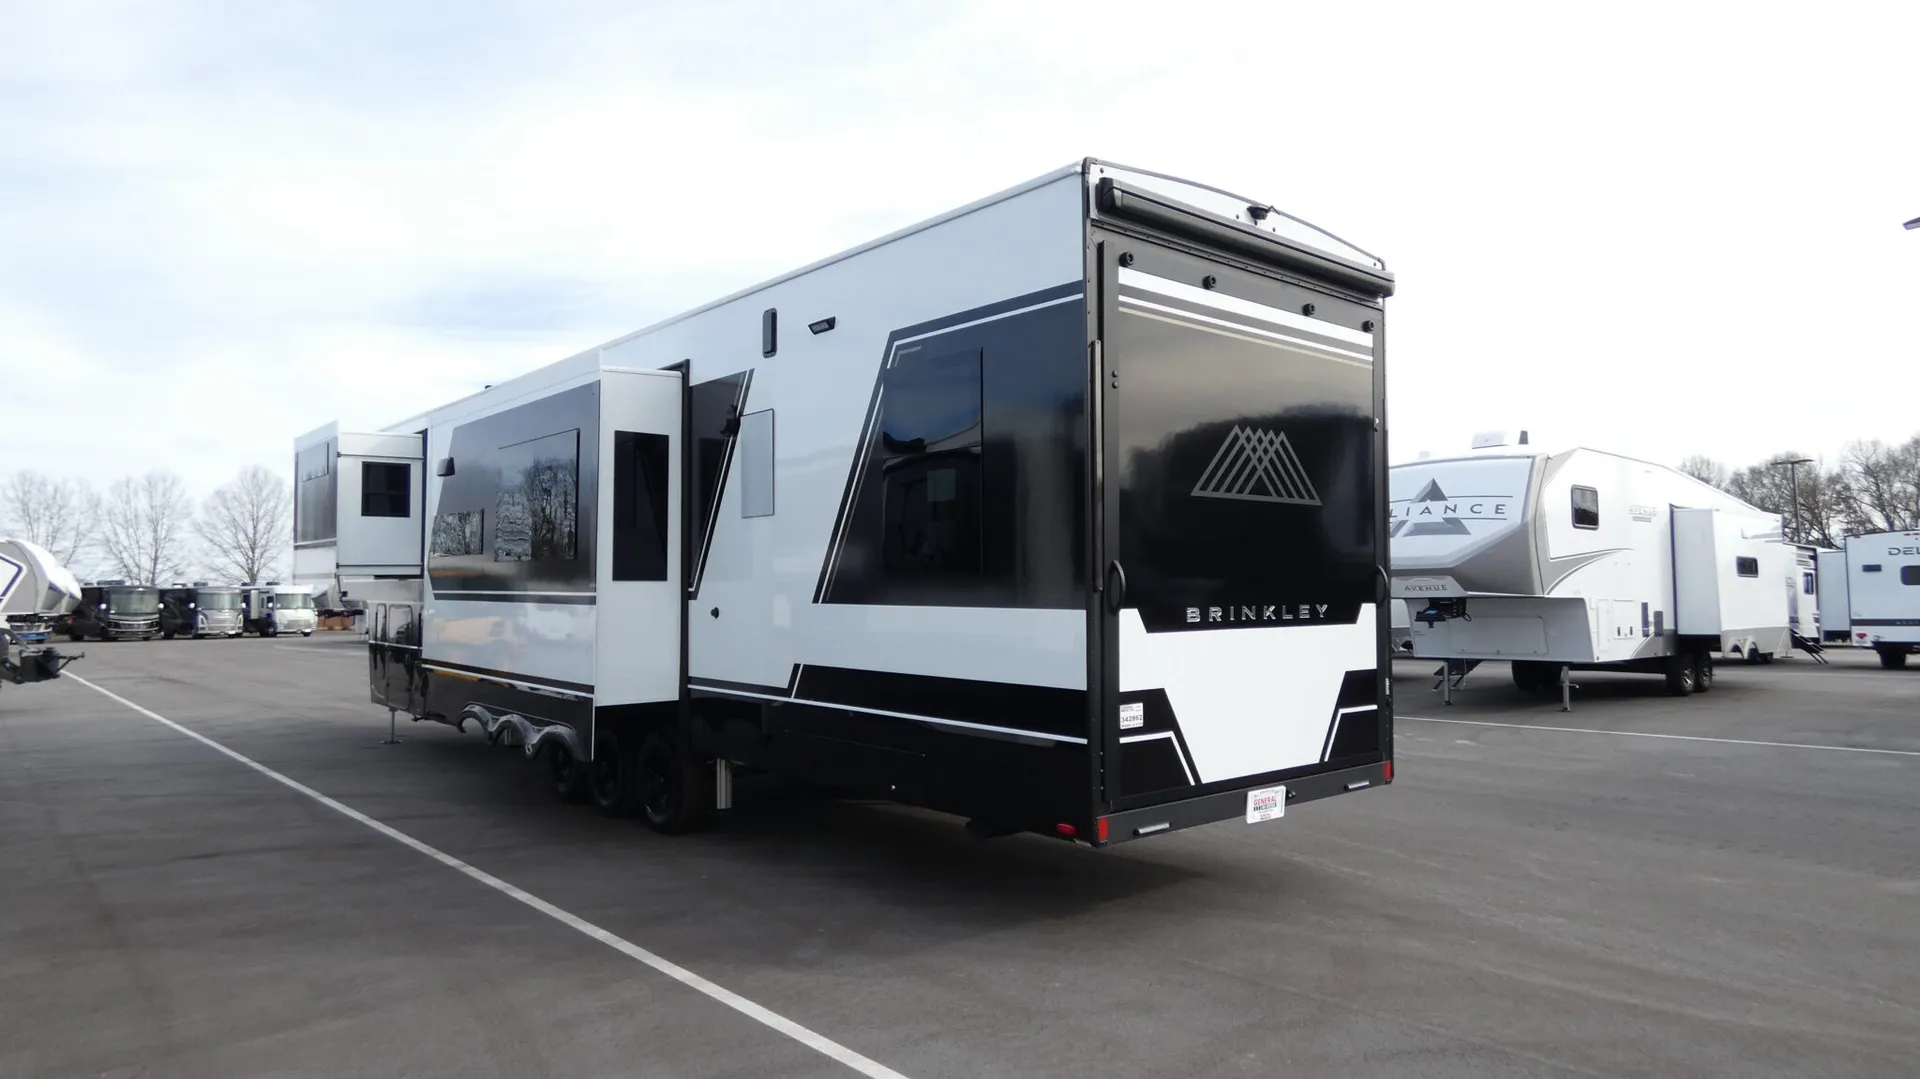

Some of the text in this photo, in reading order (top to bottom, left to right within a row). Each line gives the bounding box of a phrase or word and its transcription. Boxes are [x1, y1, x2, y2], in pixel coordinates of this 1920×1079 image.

[1405, 584, 1448, 592] AVENUE
[1186, 604, 1328, 623] BRINKLEY
[1253, 795, 1277, 806] GENERAL
